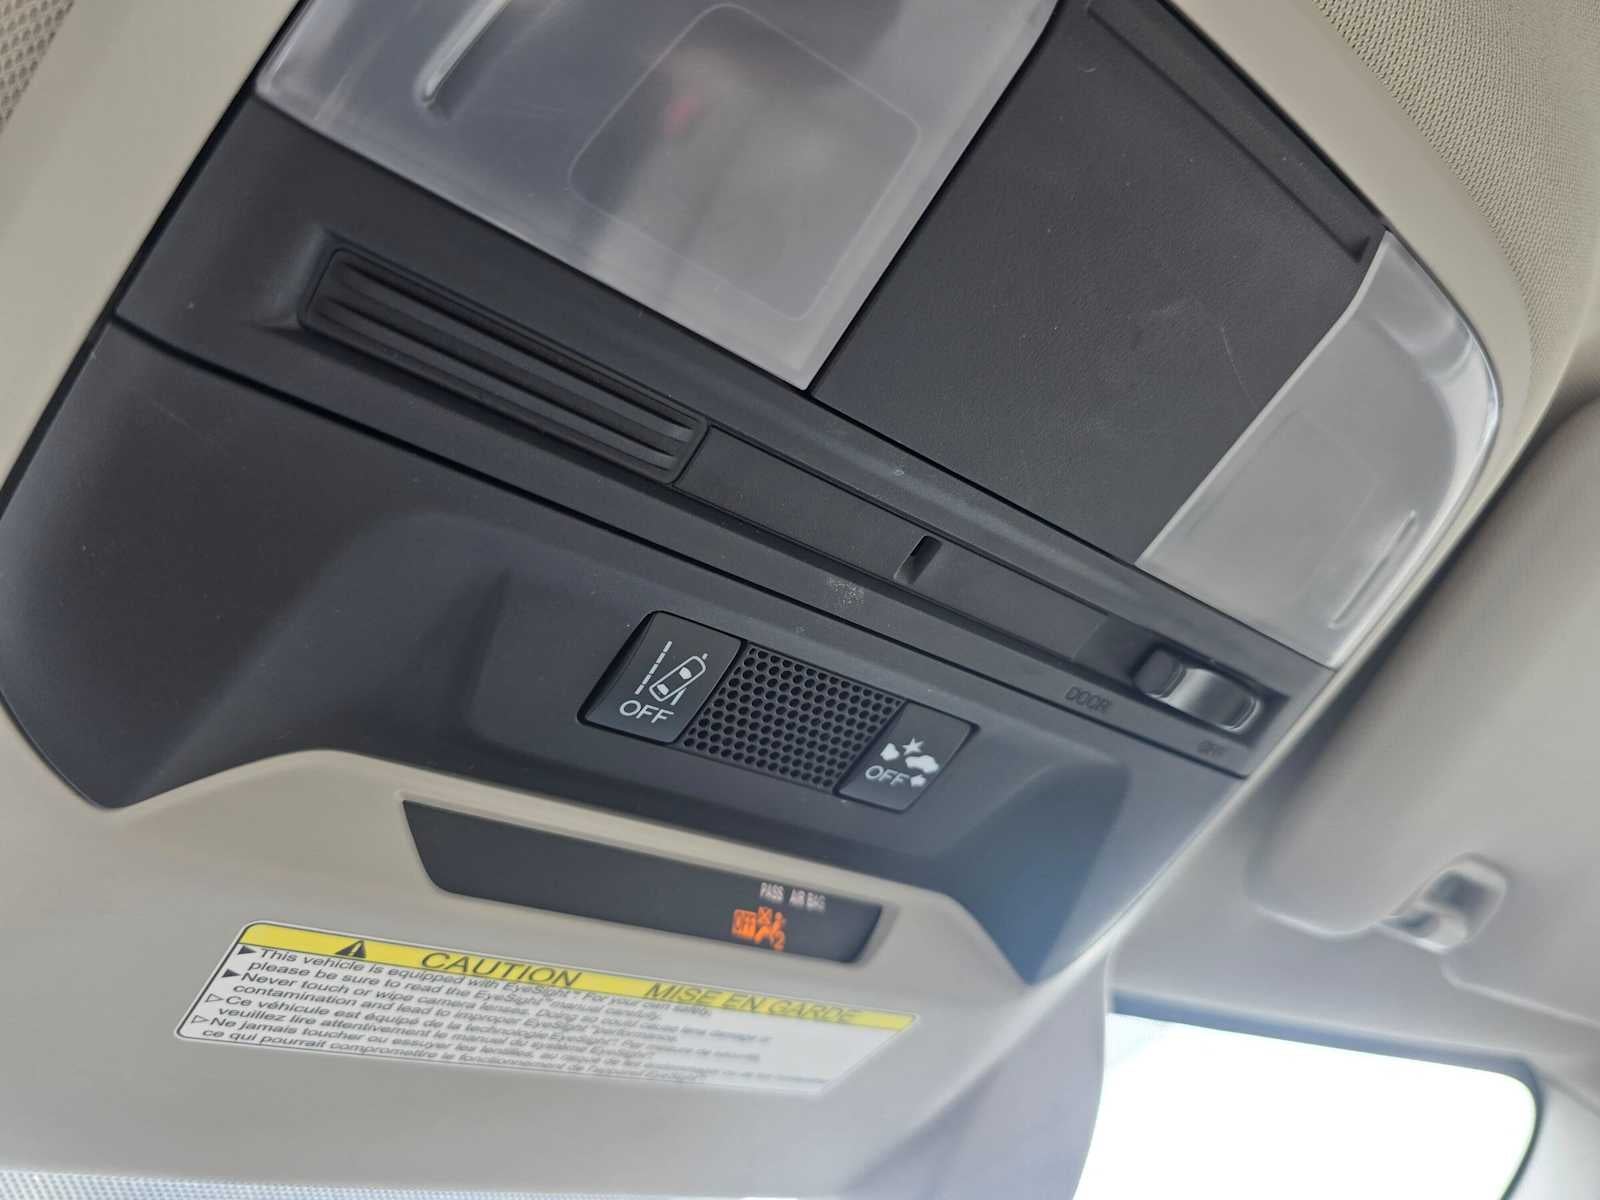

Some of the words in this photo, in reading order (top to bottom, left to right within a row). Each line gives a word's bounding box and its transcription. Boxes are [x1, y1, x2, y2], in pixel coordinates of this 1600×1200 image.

[619, 700, 674, 724] OFF
[1064, 686, 1112, 714] DOOR
[865, 764, 910, 787] OFF
[760, 882, 784, 901] PASS
[249, 962, 311, 976] please
[316, 970, 340, 979] be
[343, 974, 381, 984] sure
[386, 979, 403, 987] to
[406, 981, 444, 992] read
[447, 987, 472, 996] the
[259, 950, 298, 962] This
[303, 955, 366, 970] vehicle
[371, 965, 385, 973] is
[387, 968, 465, 985] equipped
[468, 978, 500, 988] with
[421, 952, 582, 987] CAUTION
[233, 985, 359, 1005] contamination
[362, 1000, 394, 1009] and
[397, 1004, 433, 1014] lead
[242, 973, 297, 986] Never
[301, 980, 351, 993] touch
[375, 990, 415, 1001] wipe
[645, 983, 723, 1005] MISE
[722, 994, 768, 1012] EN
[218, 1007, 287, 1021] veuillez
[291, 1015, 318, 1024] lire
[226, 996, 254, 1006] Ce
[258, 1000, 332, 1014] véhicule
[335, 1009, 361, 1017] est
[211, 1018, 237, 1027] Ne
[240, 1021, 299, 1033] jamais
[229, 1032, 258, 1041] qui
